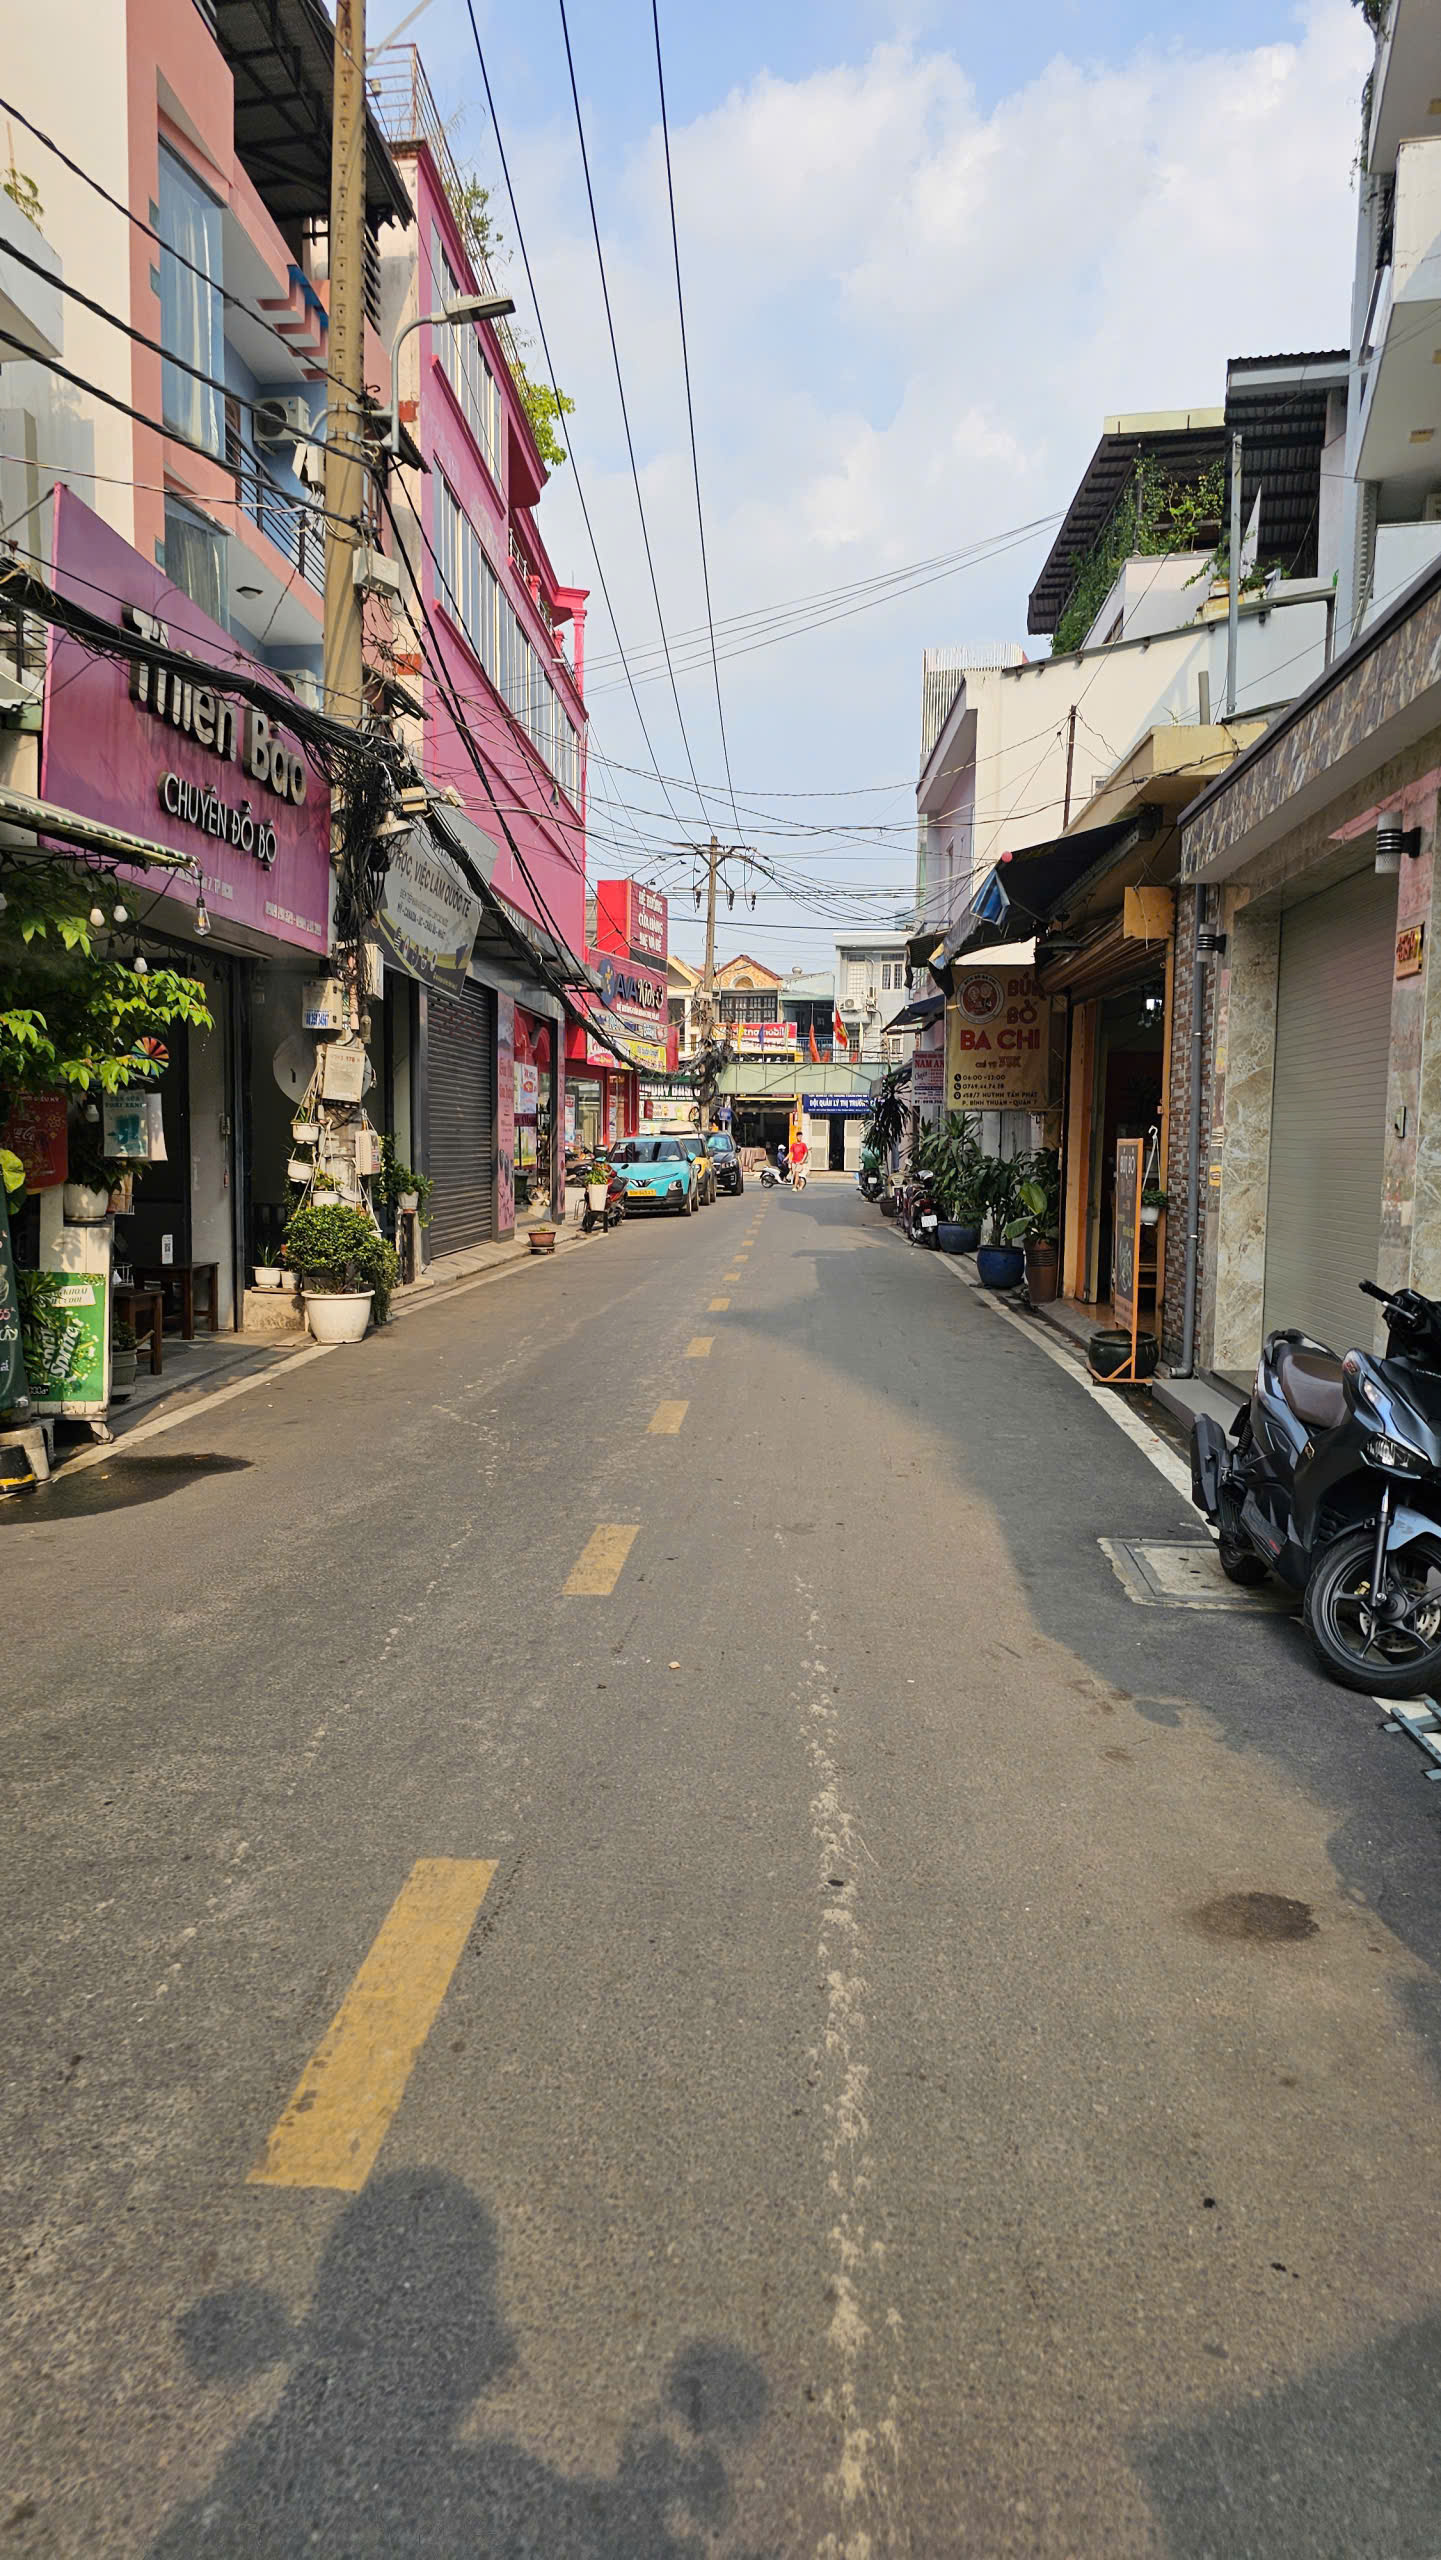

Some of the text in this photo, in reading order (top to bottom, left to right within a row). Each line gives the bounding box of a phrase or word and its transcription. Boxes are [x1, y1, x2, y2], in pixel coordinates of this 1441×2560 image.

[164, 772, 278, 873] CHUYÊN ĐỒ BỘ
[960, 1029, 1040, 1050] BA CHI
[915, 1060, 932, 1068] NAM
[639, 1083, 669, 1096] UNDAY
[50, 1326, 80, 1379] Sprite
